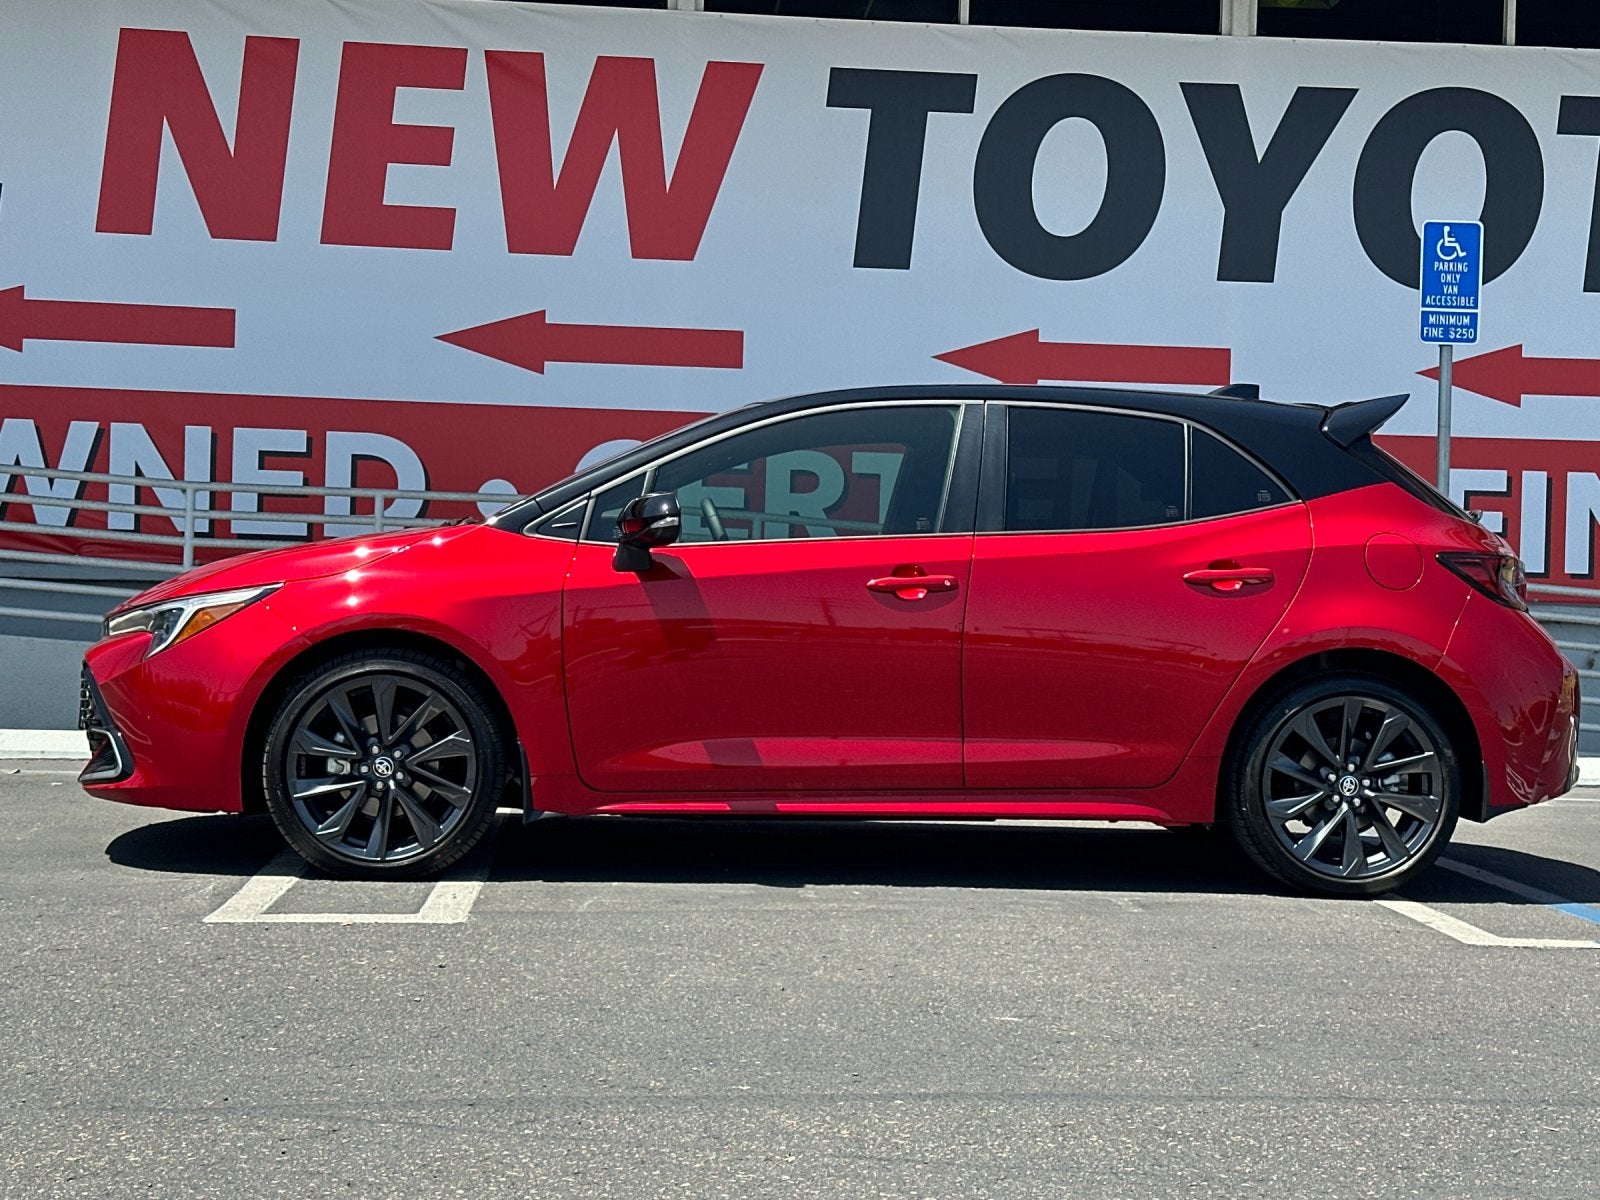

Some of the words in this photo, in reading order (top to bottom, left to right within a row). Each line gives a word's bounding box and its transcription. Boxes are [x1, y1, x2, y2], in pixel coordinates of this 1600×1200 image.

[95, 27, 764, 261] NEW
[1434, 261, 1468, 273] PARKING
[1440, 273, 1461, 284] ONLY
[1443, 284, 1459, 295] VAN
[1425, 295, 1475, 307] ACCESSIBLE
[1428, 314, 1470, 326] MINIMUM
[1423, 326, 1444, 338] FINE
[1448, 327, 1474, 339] $250
